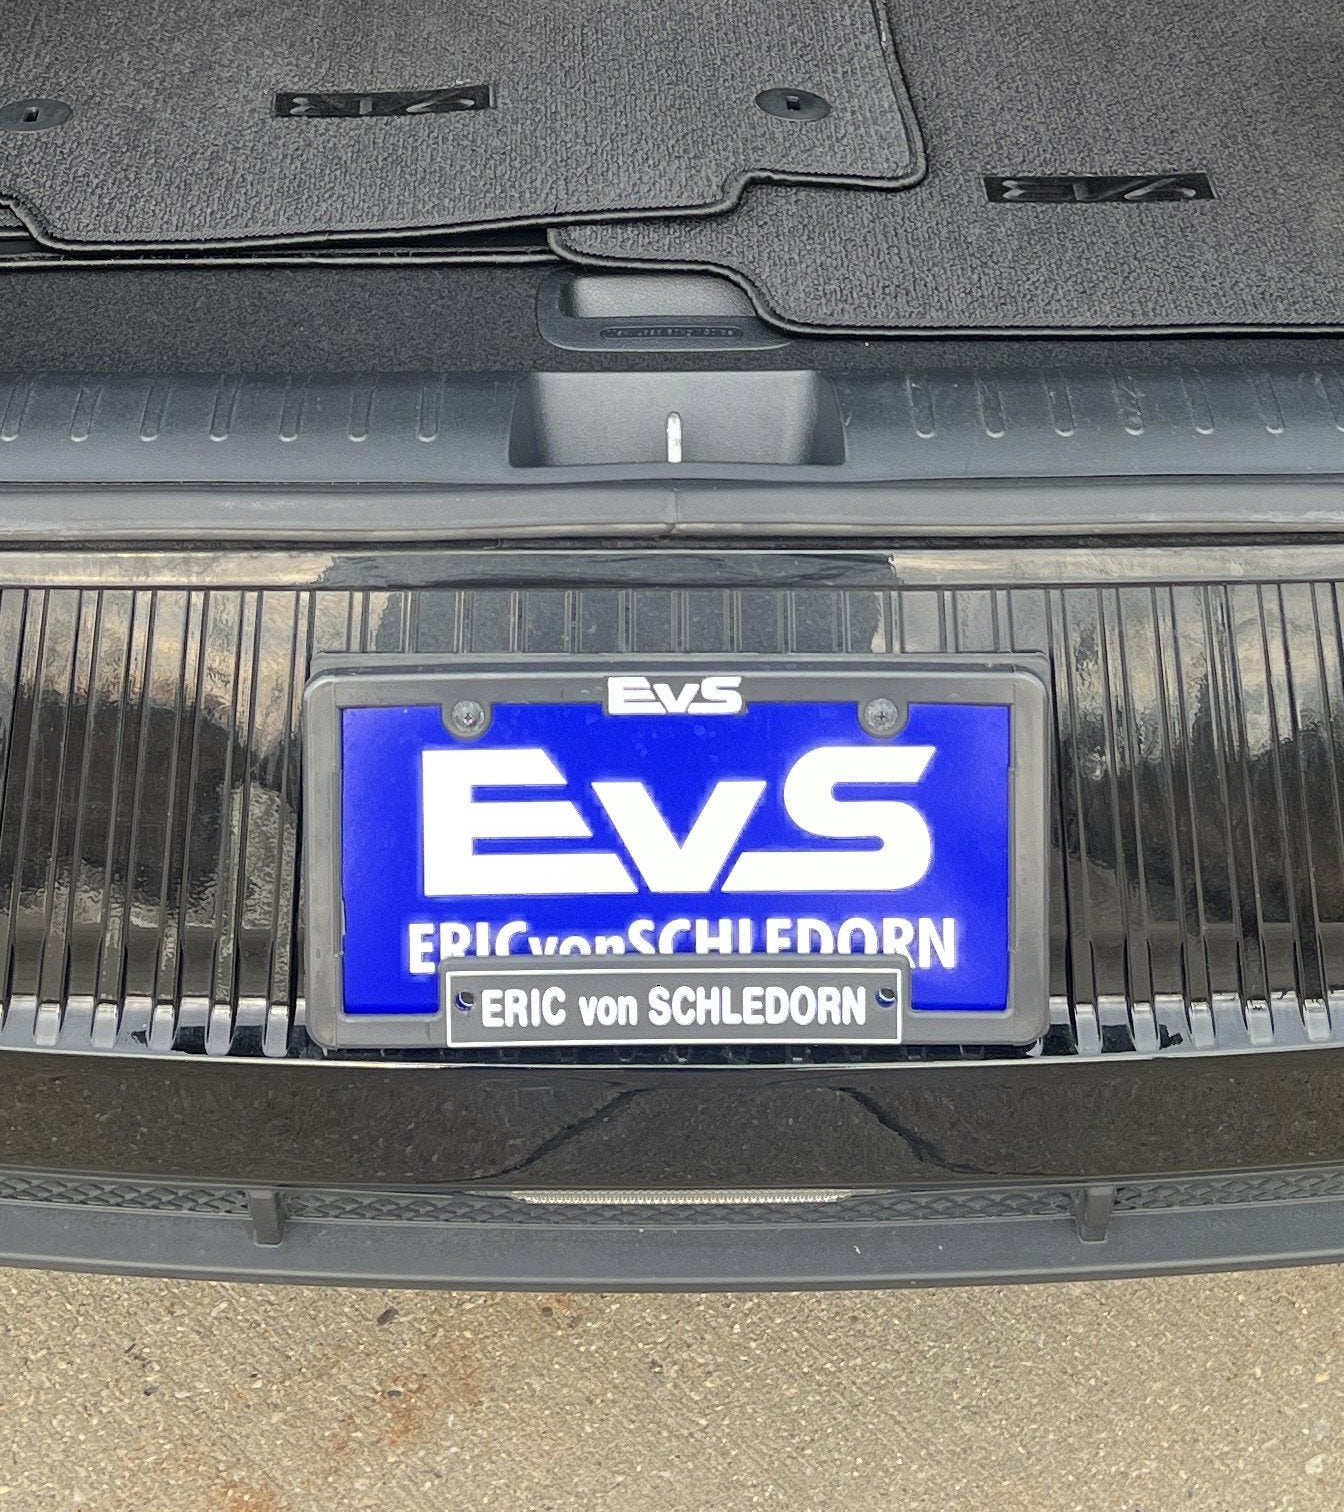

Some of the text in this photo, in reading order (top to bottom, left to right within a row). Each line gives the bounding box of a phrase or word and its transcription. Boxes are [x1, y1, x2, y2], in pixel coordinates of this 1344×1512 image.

[481, 986, 866, 1028] ERIC von SCHLEDORN
